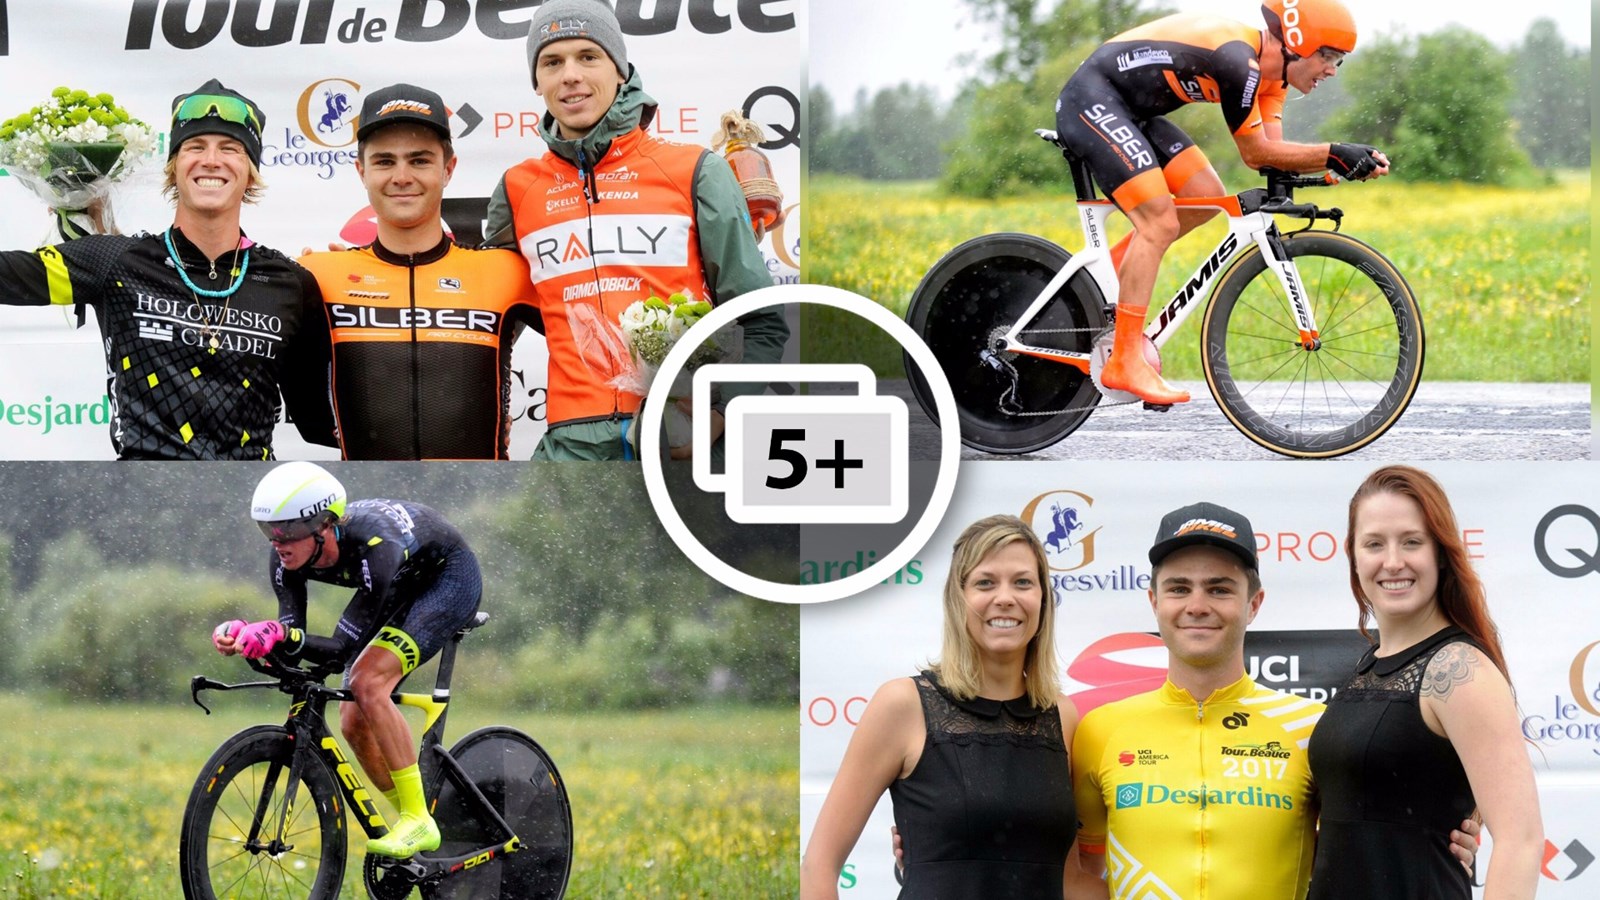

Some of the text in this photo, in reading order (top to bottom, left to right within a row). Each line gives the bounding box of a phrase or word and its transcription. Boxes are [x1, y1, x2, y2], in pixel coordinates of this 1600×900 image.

[337, 8, 387, 43] de
[541, 20, 587, 33] RALLY
[286, 127, 305, 149] le
[1084, 104, 1153, 169] SILBER
[546, 180, 579, 196] ACURA
[597, 191, 639, 200] KENDA
[553, 195, 580, 209] KELLY
[1085, 207, 1101, 248] SILBER
[536, 226, 668, 269] RALLY
[562, 277, 644, 302] DIAMONDBACK
[1151, 232, 1238, 342] JAMIS
[1282, 263, 1308, 329] JAMIS
[135, 292, 282, 334] HOLOWESKO
[332, 304, 497, 333] SILBER
[254, 506, 271, 514] GIRO
[300, 493, 337, 519] GIRO
[376, 631, 416, 669] MAVIC
[1556, 695, 1579, 720] le
[1221, 746, 1246, 757] Tour
[1250, 748, 1291, 759] Beauce
[1222, 757, 1289, 780] 2017
[321, 736, 392, 833] FELT
[1146, 783, 1294, 811] Desjardins
